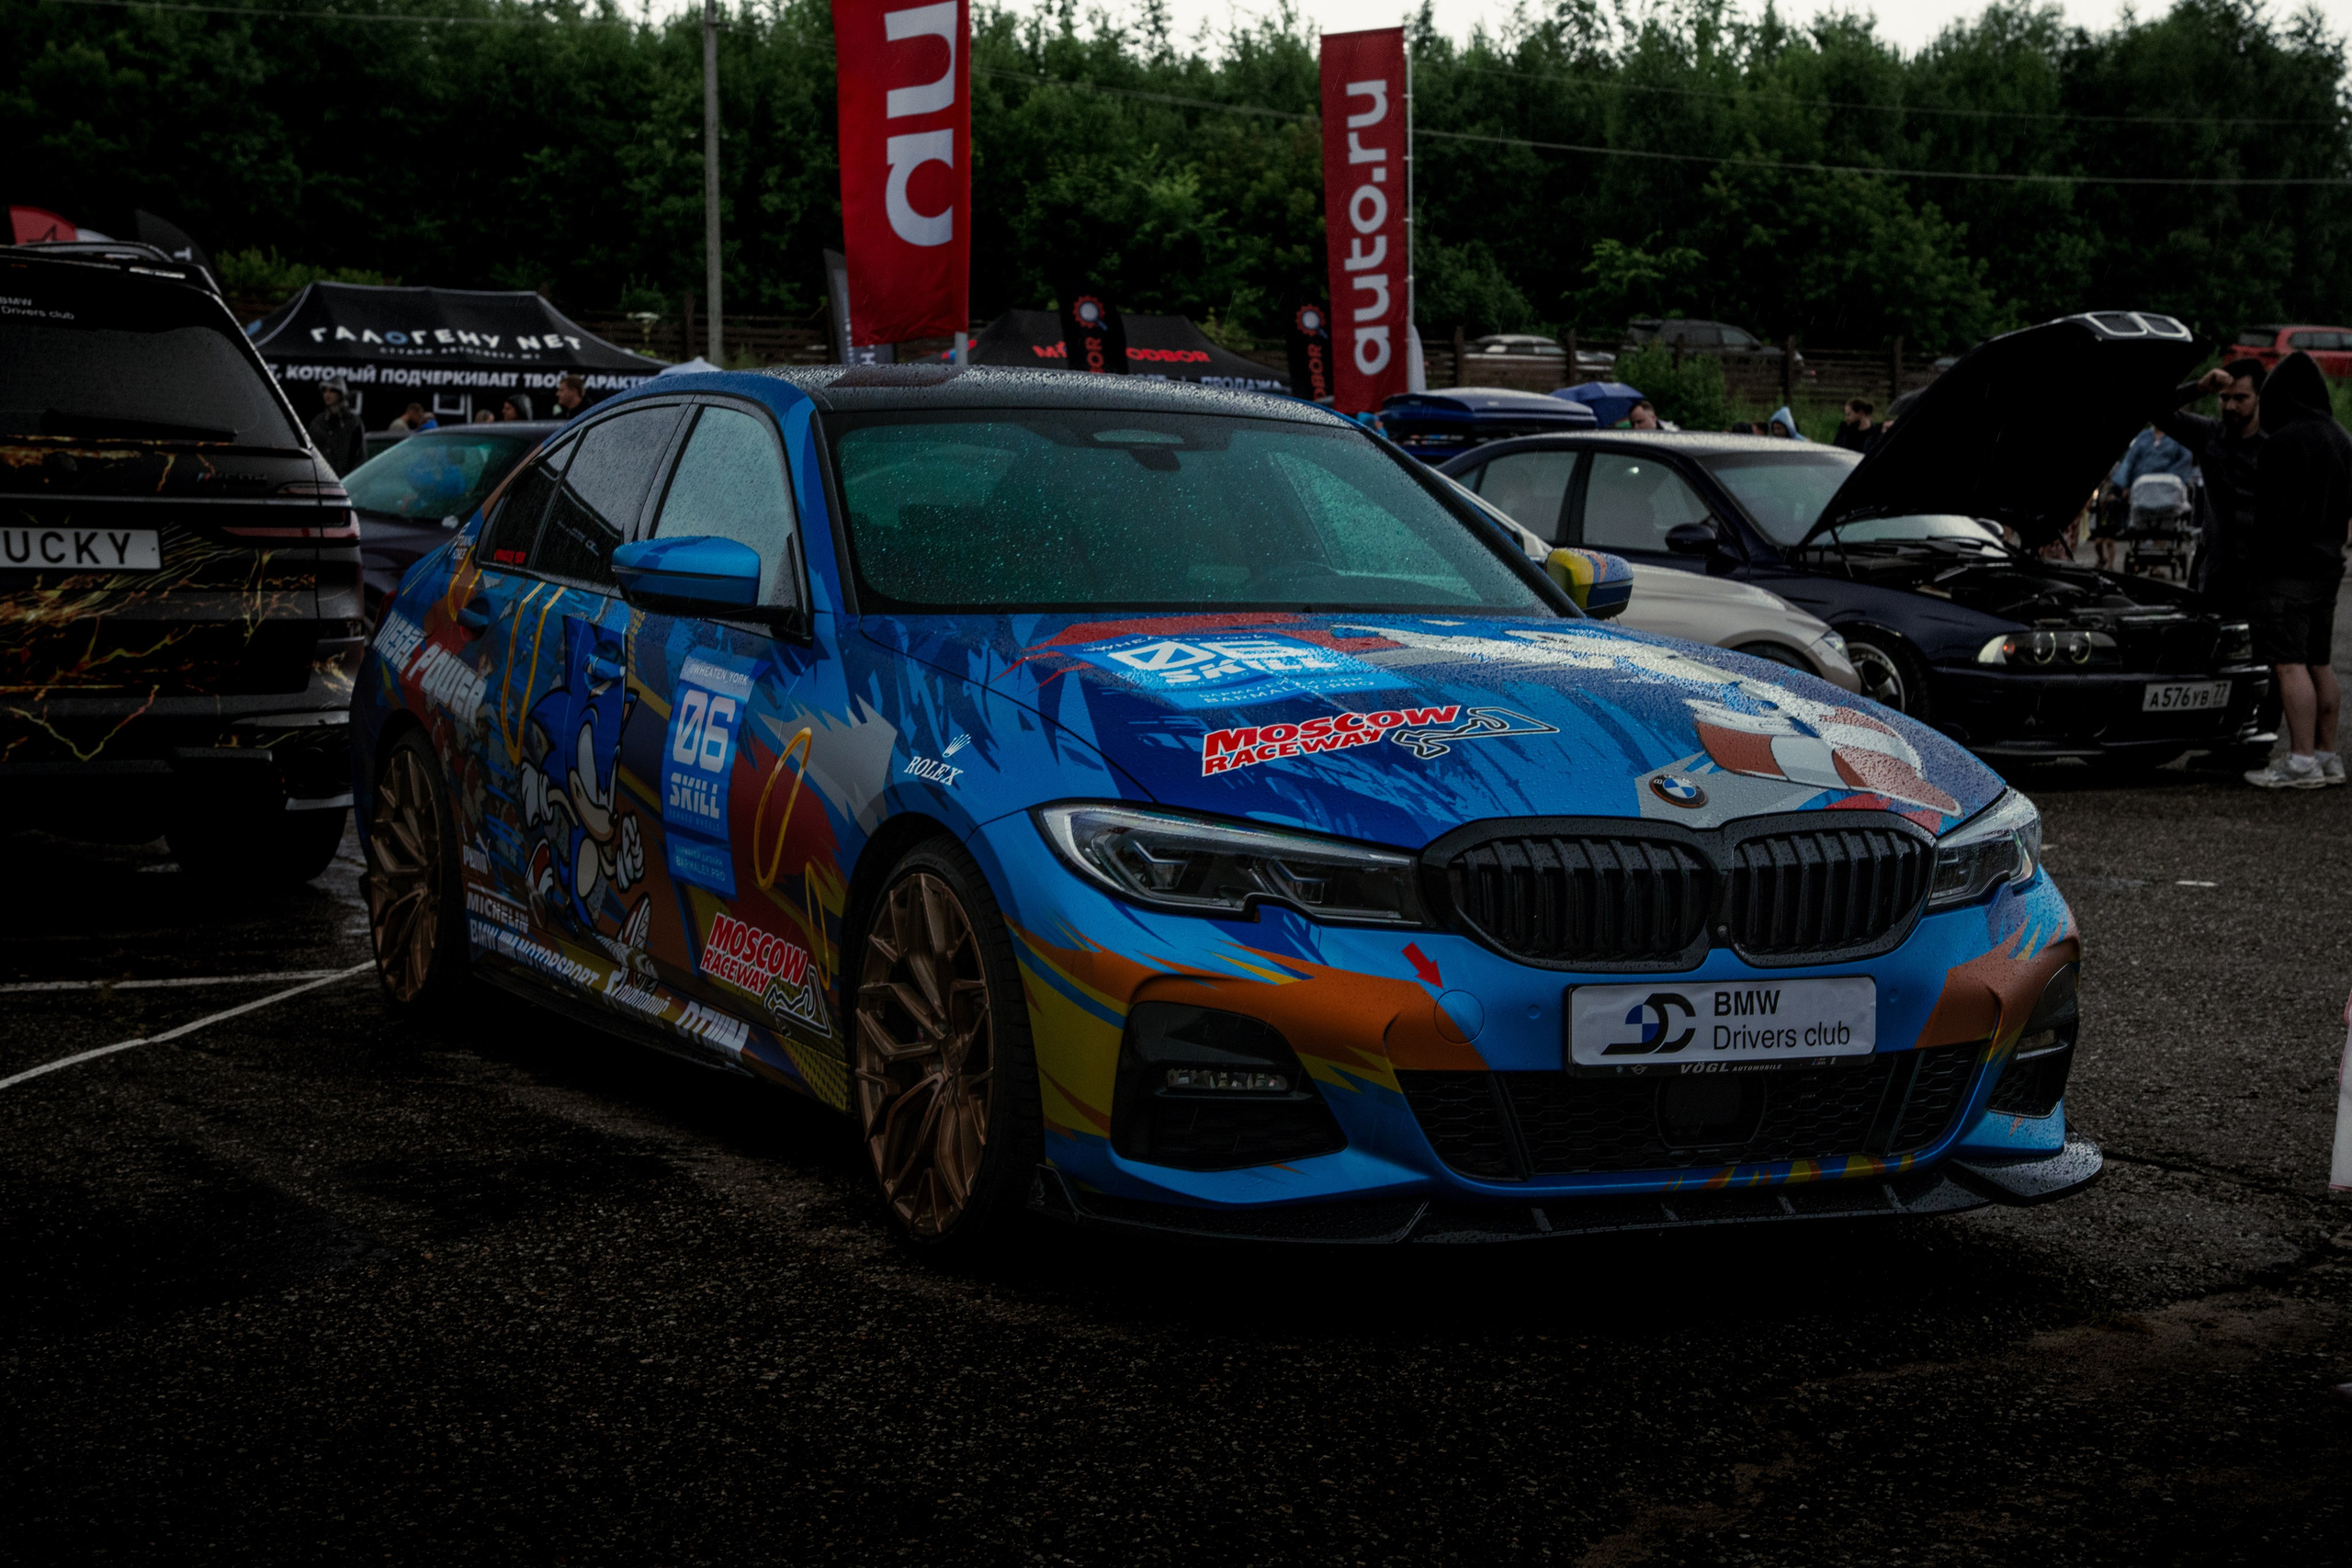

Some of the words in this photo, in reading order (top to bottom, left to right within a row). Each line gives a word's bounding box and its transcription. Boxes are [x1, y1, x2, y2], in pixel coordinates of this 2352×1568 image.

[1344, 79, 1391, 376] auto.ru
[49, 310, 75, 320] club
[516, 333, 582, 351] NET
[379, 367, 519, 389] ПОДЧЕРКИВАЕТ
[406, 641, 488, 727] POWER
[1202, 705, 1462, 761] MOSCOW
[1202, 728, 1383, 776] RACEWAY
[903, 755, 965, 786] ROLEX
[669, 772, 720, 820] SKILL
[467, 890, 530, 934] MICHELIN
[469, 918, 500, 951] BMW
[707, 912, 808, 987] MOSCOW
[700, 947, 771, 997] RACEWAY
[1714, 989, 1781, 1017] BMW
[1713, 1024, 1797, 1051] Drivers
[1804, 1021, 1850, 1046] club
[1680, 1061, 1730, 1075] VÖGL
[1732, 1064, 1782, 1072] AUTOMOBILE
